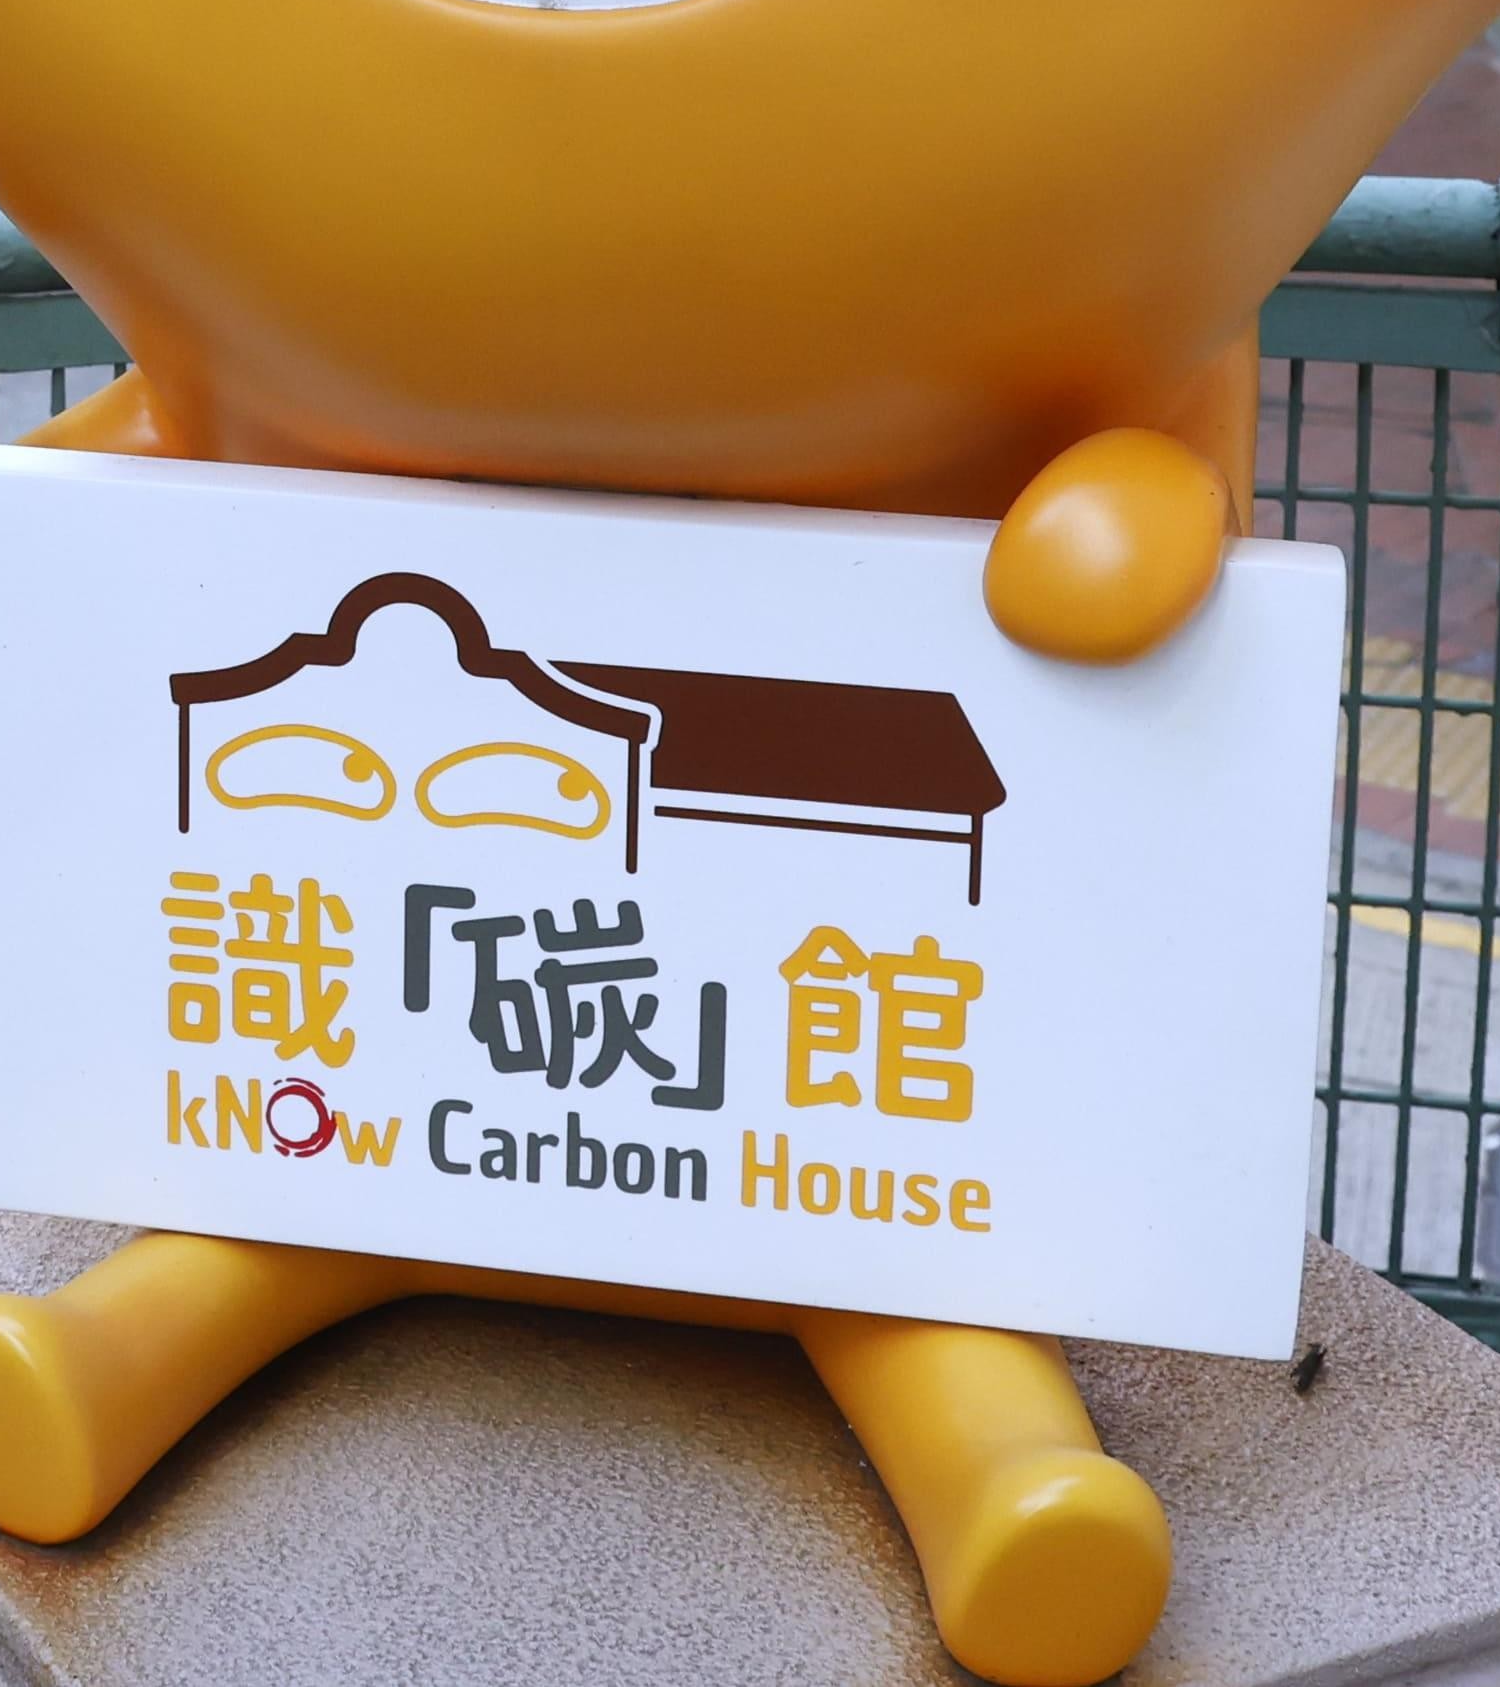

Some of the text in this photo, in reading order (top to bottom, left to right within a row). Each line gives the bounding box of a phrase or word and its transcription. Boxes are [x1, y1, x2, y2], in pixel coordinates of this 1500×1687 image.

[161, 871, 985, 1123] 識「碳」館
[428, 1098, 708, 1202] Carbon
[740, 1129, 992, 1233] House
